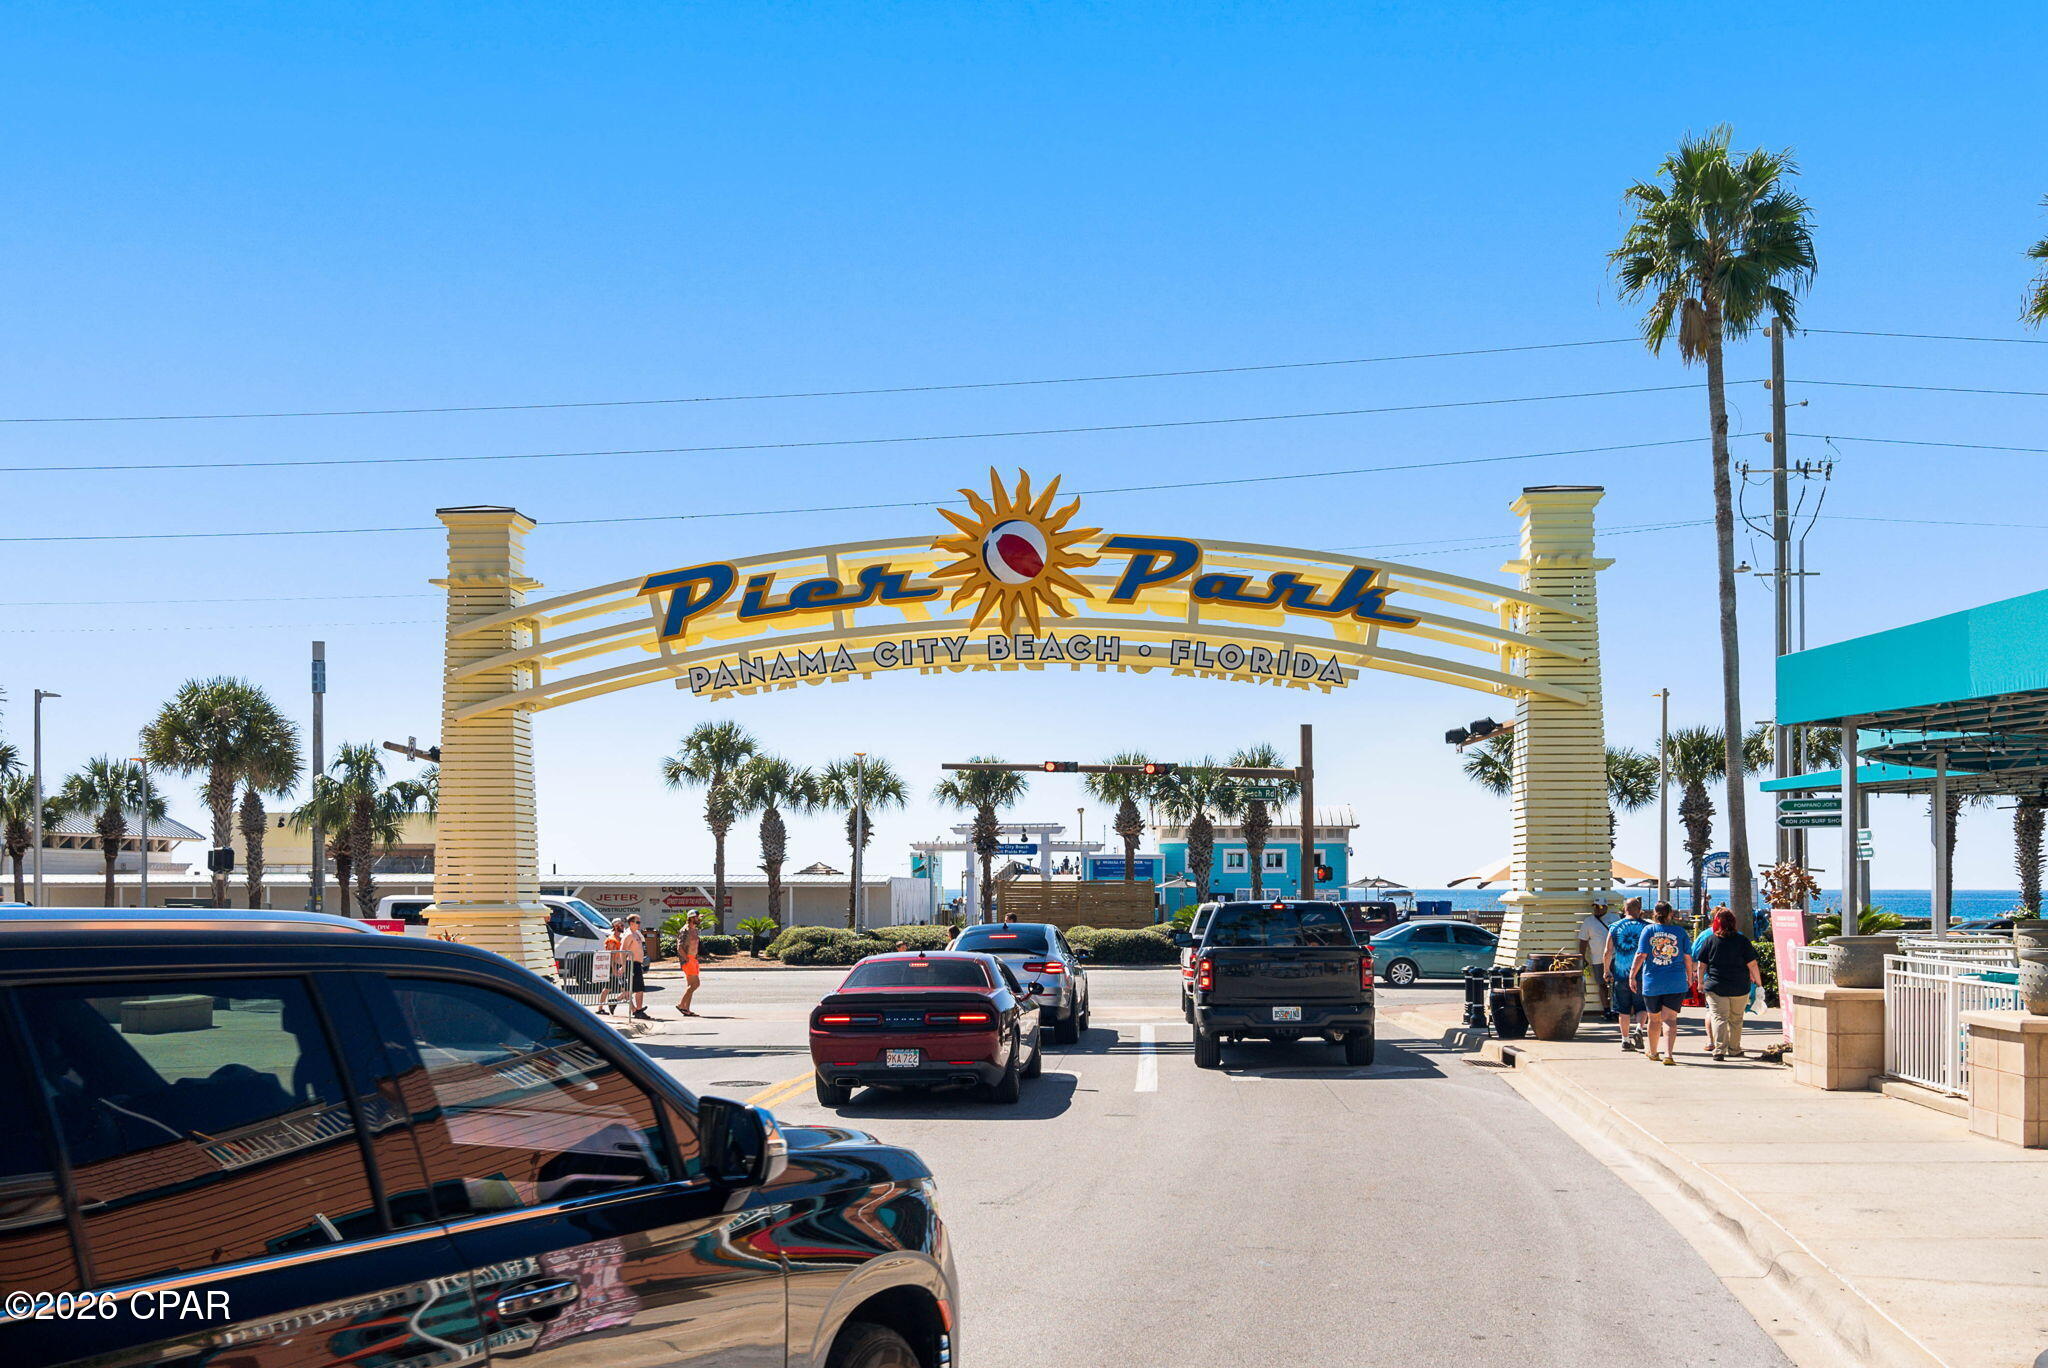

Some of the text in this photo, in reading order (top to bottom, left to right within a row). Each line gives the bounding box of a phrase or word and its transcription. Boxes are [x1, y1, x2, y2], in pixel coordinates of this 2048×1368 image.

[637, 533, 1421, 642] Pier Park
[688, 631, 1344, 693] PANAMA CITY BEACH FLORIDA
[1265, 789, 1275, 797] Rd
[597, 893, 638, 901] JETER
